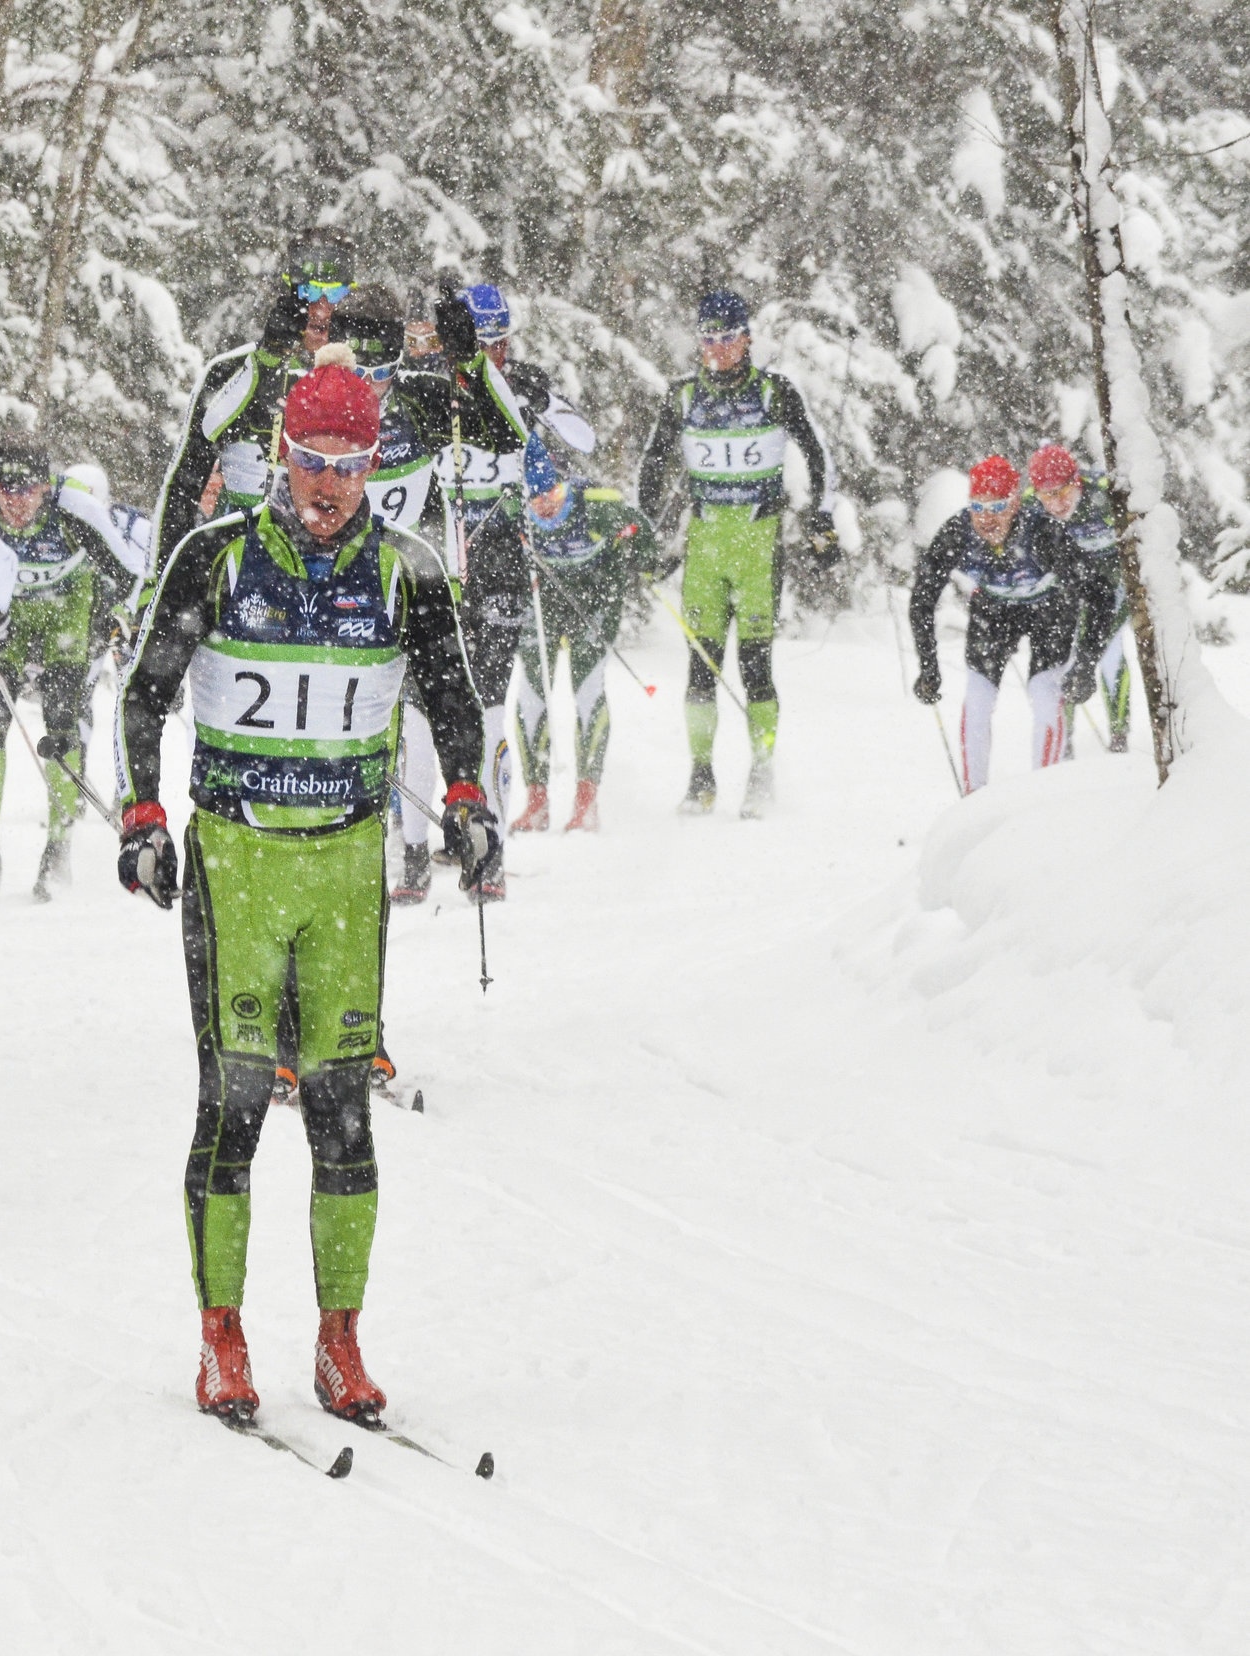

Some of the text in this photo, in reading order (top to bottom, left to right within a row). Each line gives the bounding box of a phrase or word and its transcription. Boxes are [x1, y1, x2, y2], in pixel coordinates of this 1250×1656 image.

[695, 441, 761, 467] 216
[234, 670, 359, 732] 211
[242, 769, 353, 798] Craftsbury
